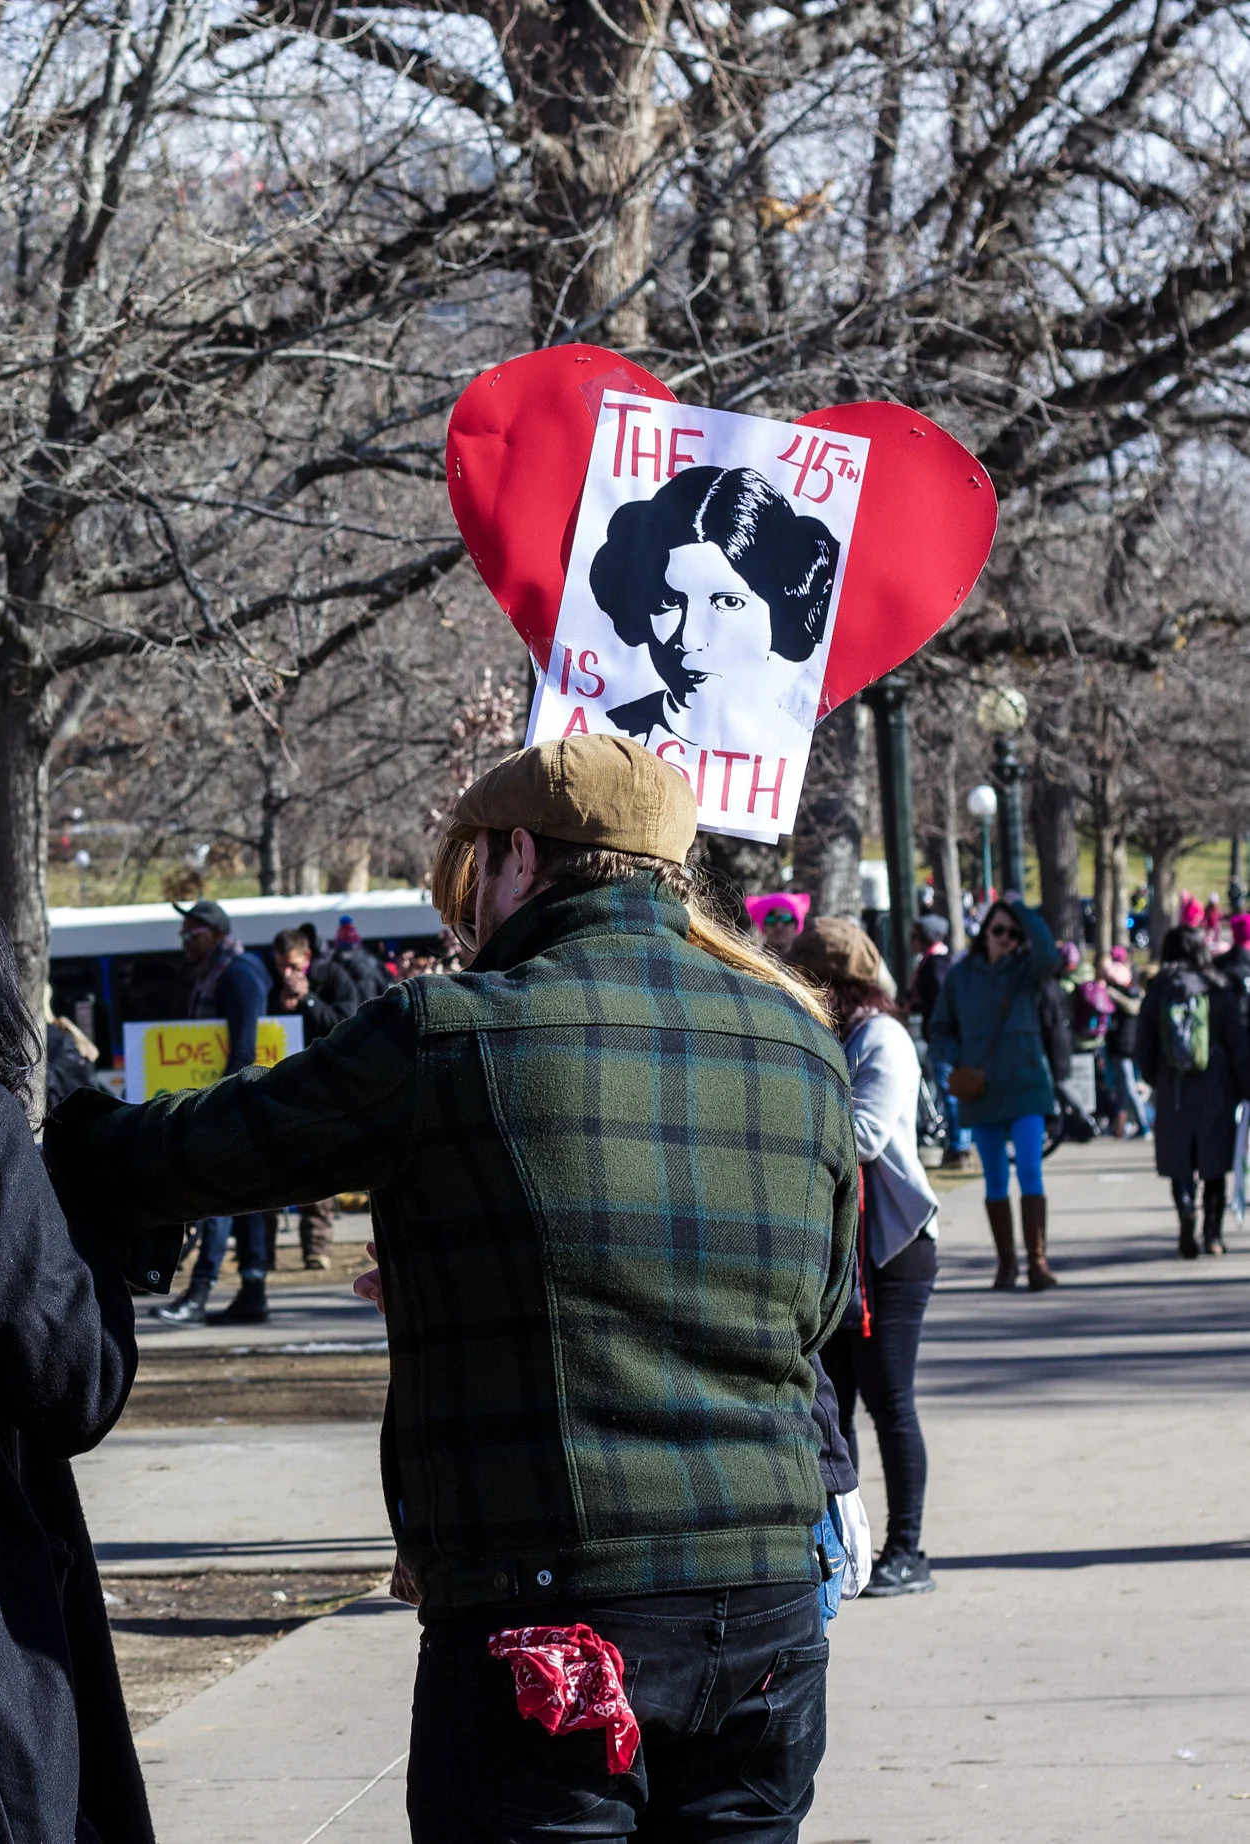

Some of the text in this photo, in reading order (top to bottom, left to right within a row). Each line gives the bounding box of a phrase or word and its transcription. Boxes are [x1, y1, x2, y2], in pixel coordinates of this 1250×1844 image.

[603, 403, 705, 482] THE
[560, 648, 605, 698] IS
[562, 706, 589, 738] A
[656, 740, 787, 819] SITH
